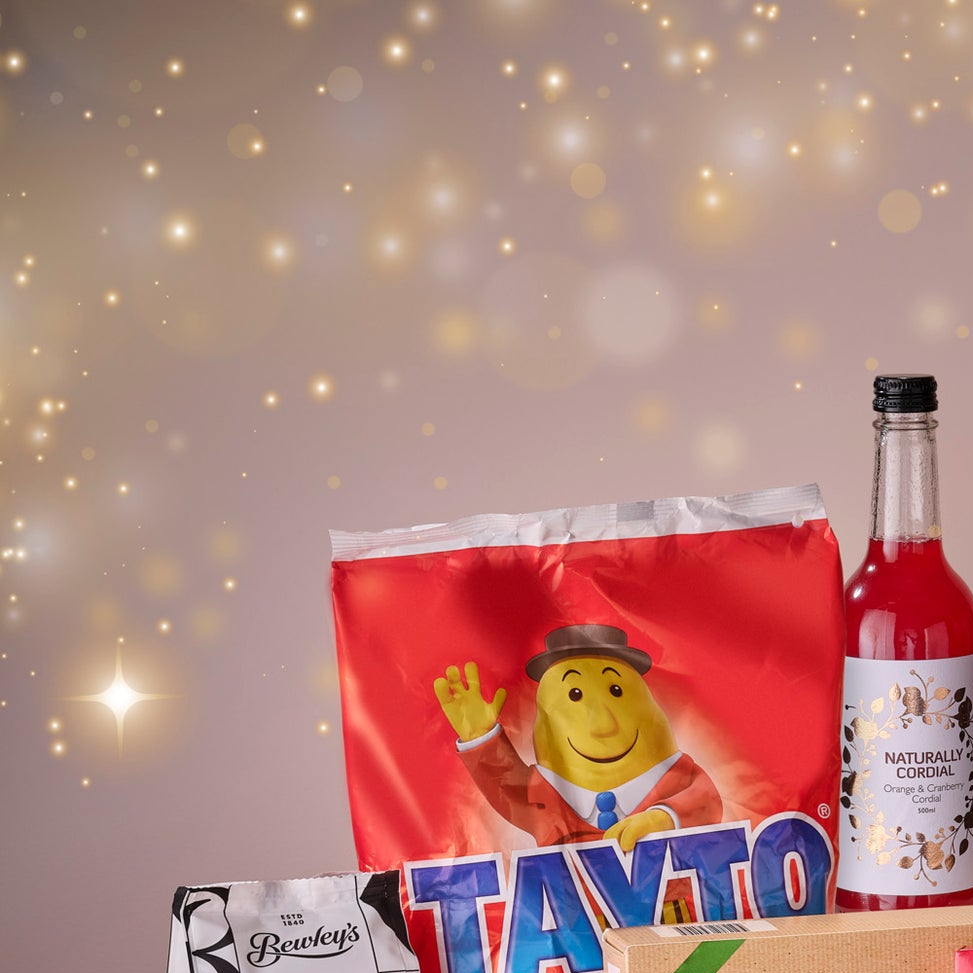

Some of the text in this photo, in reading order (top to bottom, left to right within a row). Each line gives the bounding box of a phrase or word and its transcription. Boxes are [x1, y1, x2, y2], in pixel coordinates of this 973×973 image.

[884, 749, 964, 765] NATURALLY
[896, 764, 955, 779] CORDIAL
[883, 781, 964, 794] Orange & Cranberry
[912, 794, 942, 803] Cordial
[282, 919, 305, 927] 1840
[246, 923, 360, 968] Bewley's
